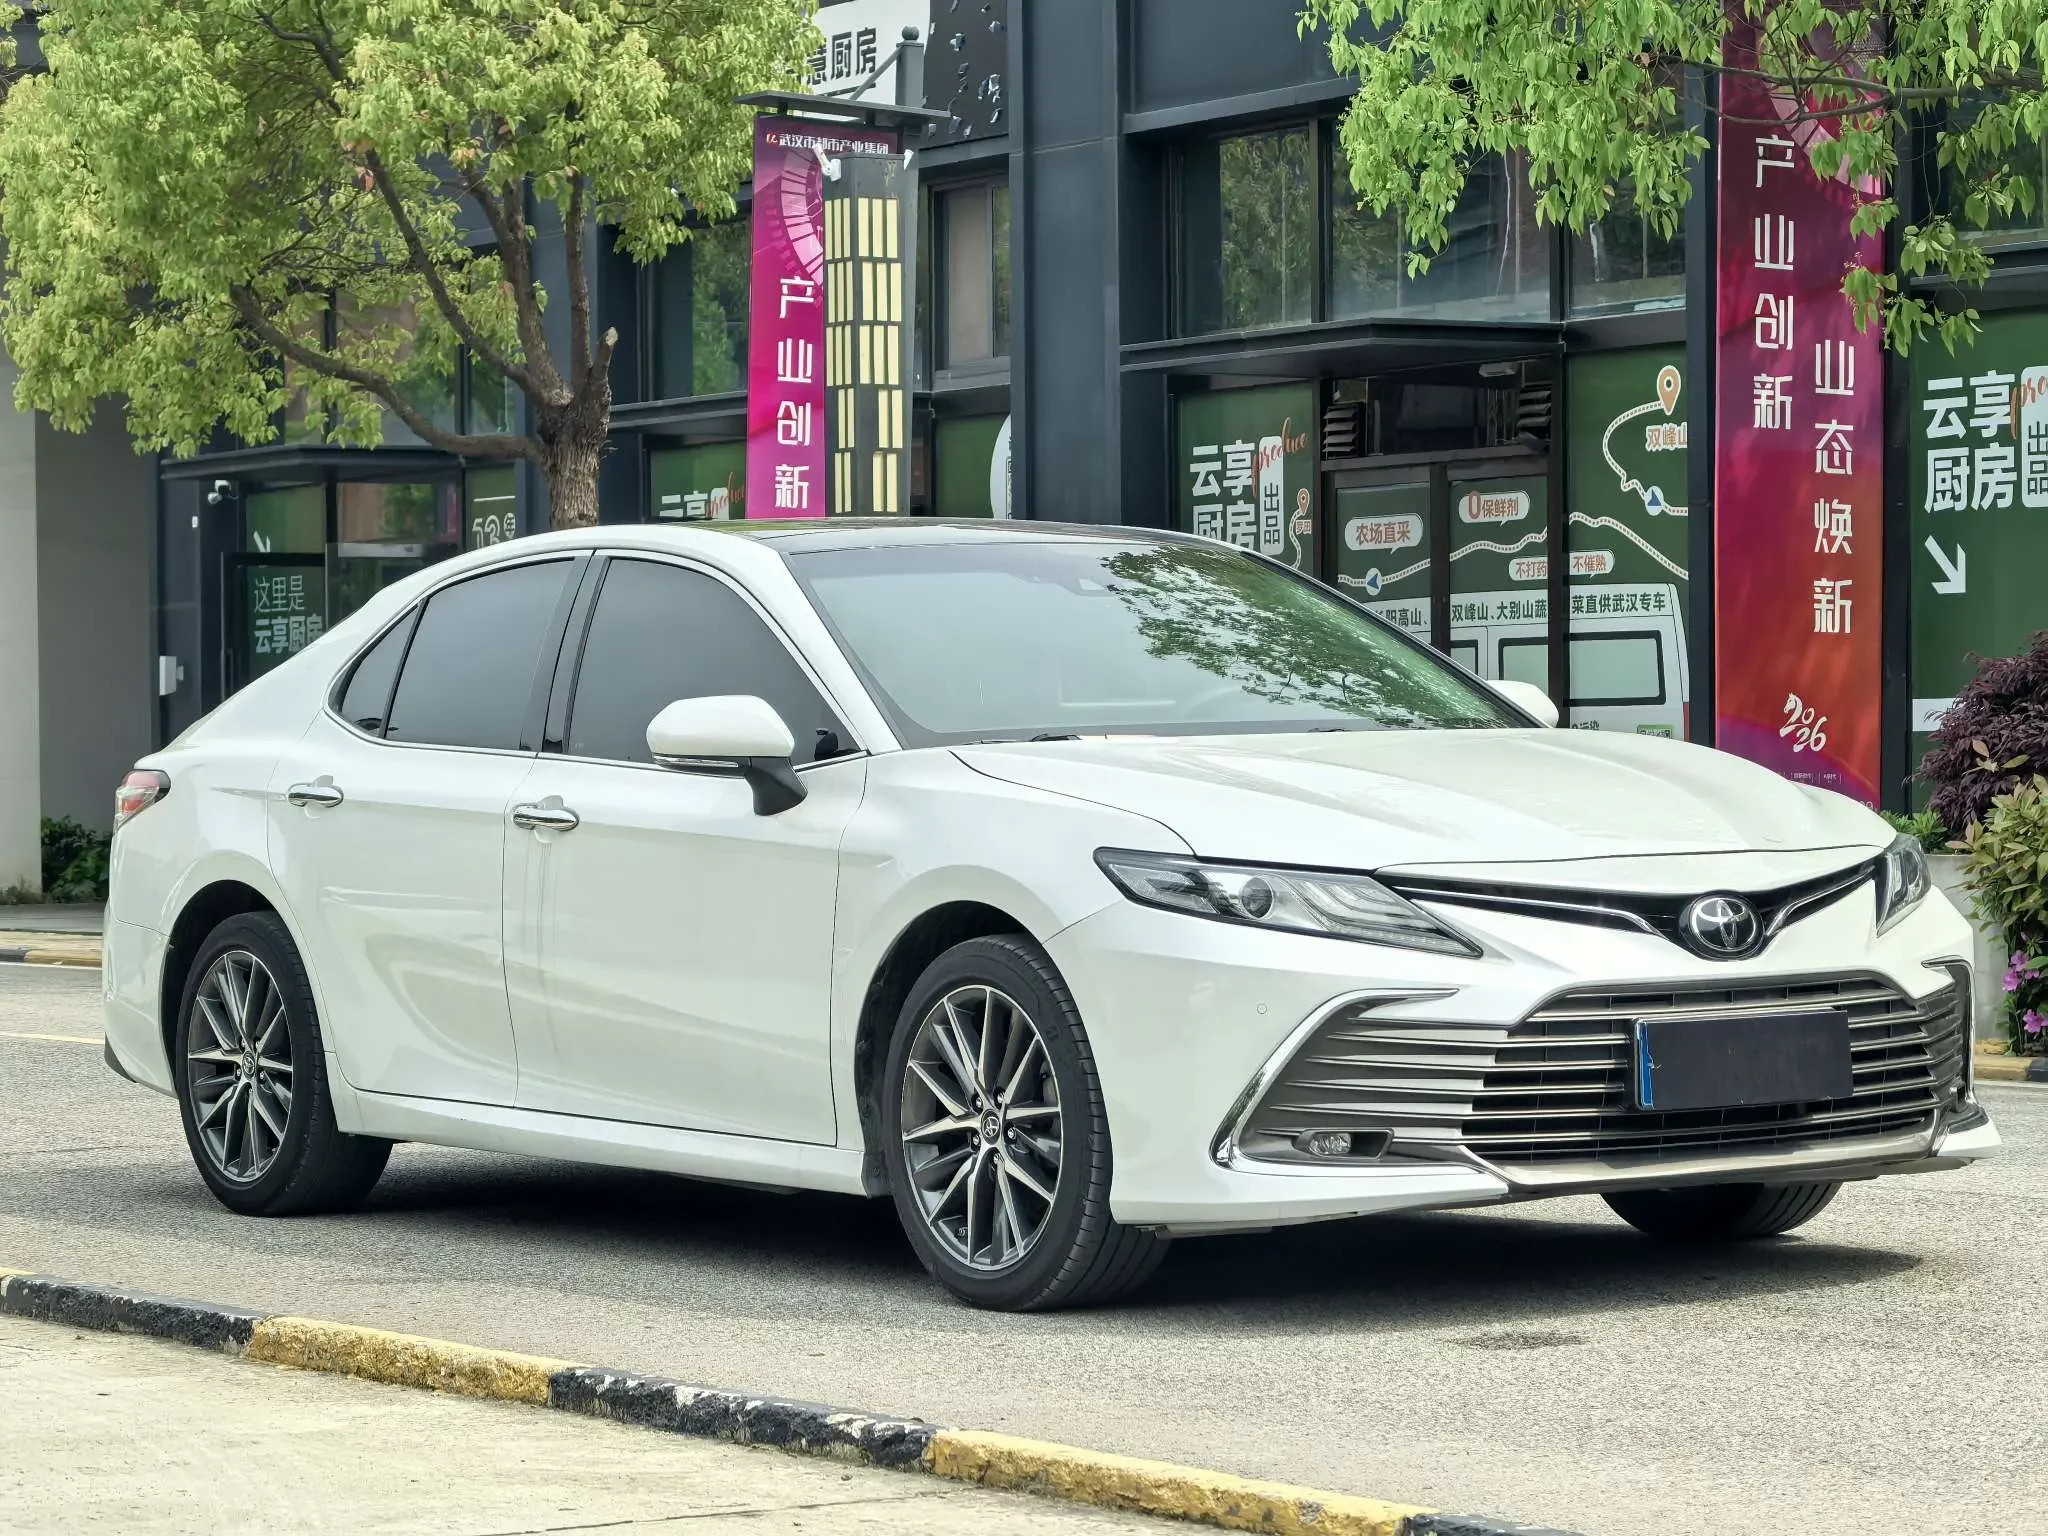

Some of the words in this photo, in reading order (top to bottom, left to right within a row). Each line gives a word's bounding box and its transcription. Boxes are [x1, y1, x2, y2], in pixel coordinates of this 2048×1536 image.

[1753, 134, 1795, 430] 产业创新
[775, 276, 815, 509] 产业创新
[1923, 370, 2016, 440] 云享
[1189, 439, 1256, 497] 云享
[1813, 339, 1855, 633] 业态焕新
[1924, 442, 2018, 513] 厨房
[1193, 500, 1257, 550] 厨房
[1263, 482, 1281, 545] 出品
[1356, 520, 1411, 546] 农场直采
[1468, 490, 1519, 520] 0保鲜剂
[254, 575, 305, 613] 这里是
[1515, 560, 1547, 580] 不打药
[1573, 554, 1607, 573] 不催熟
[1571, 592, 1666, 615] 菜直供武汉专车
